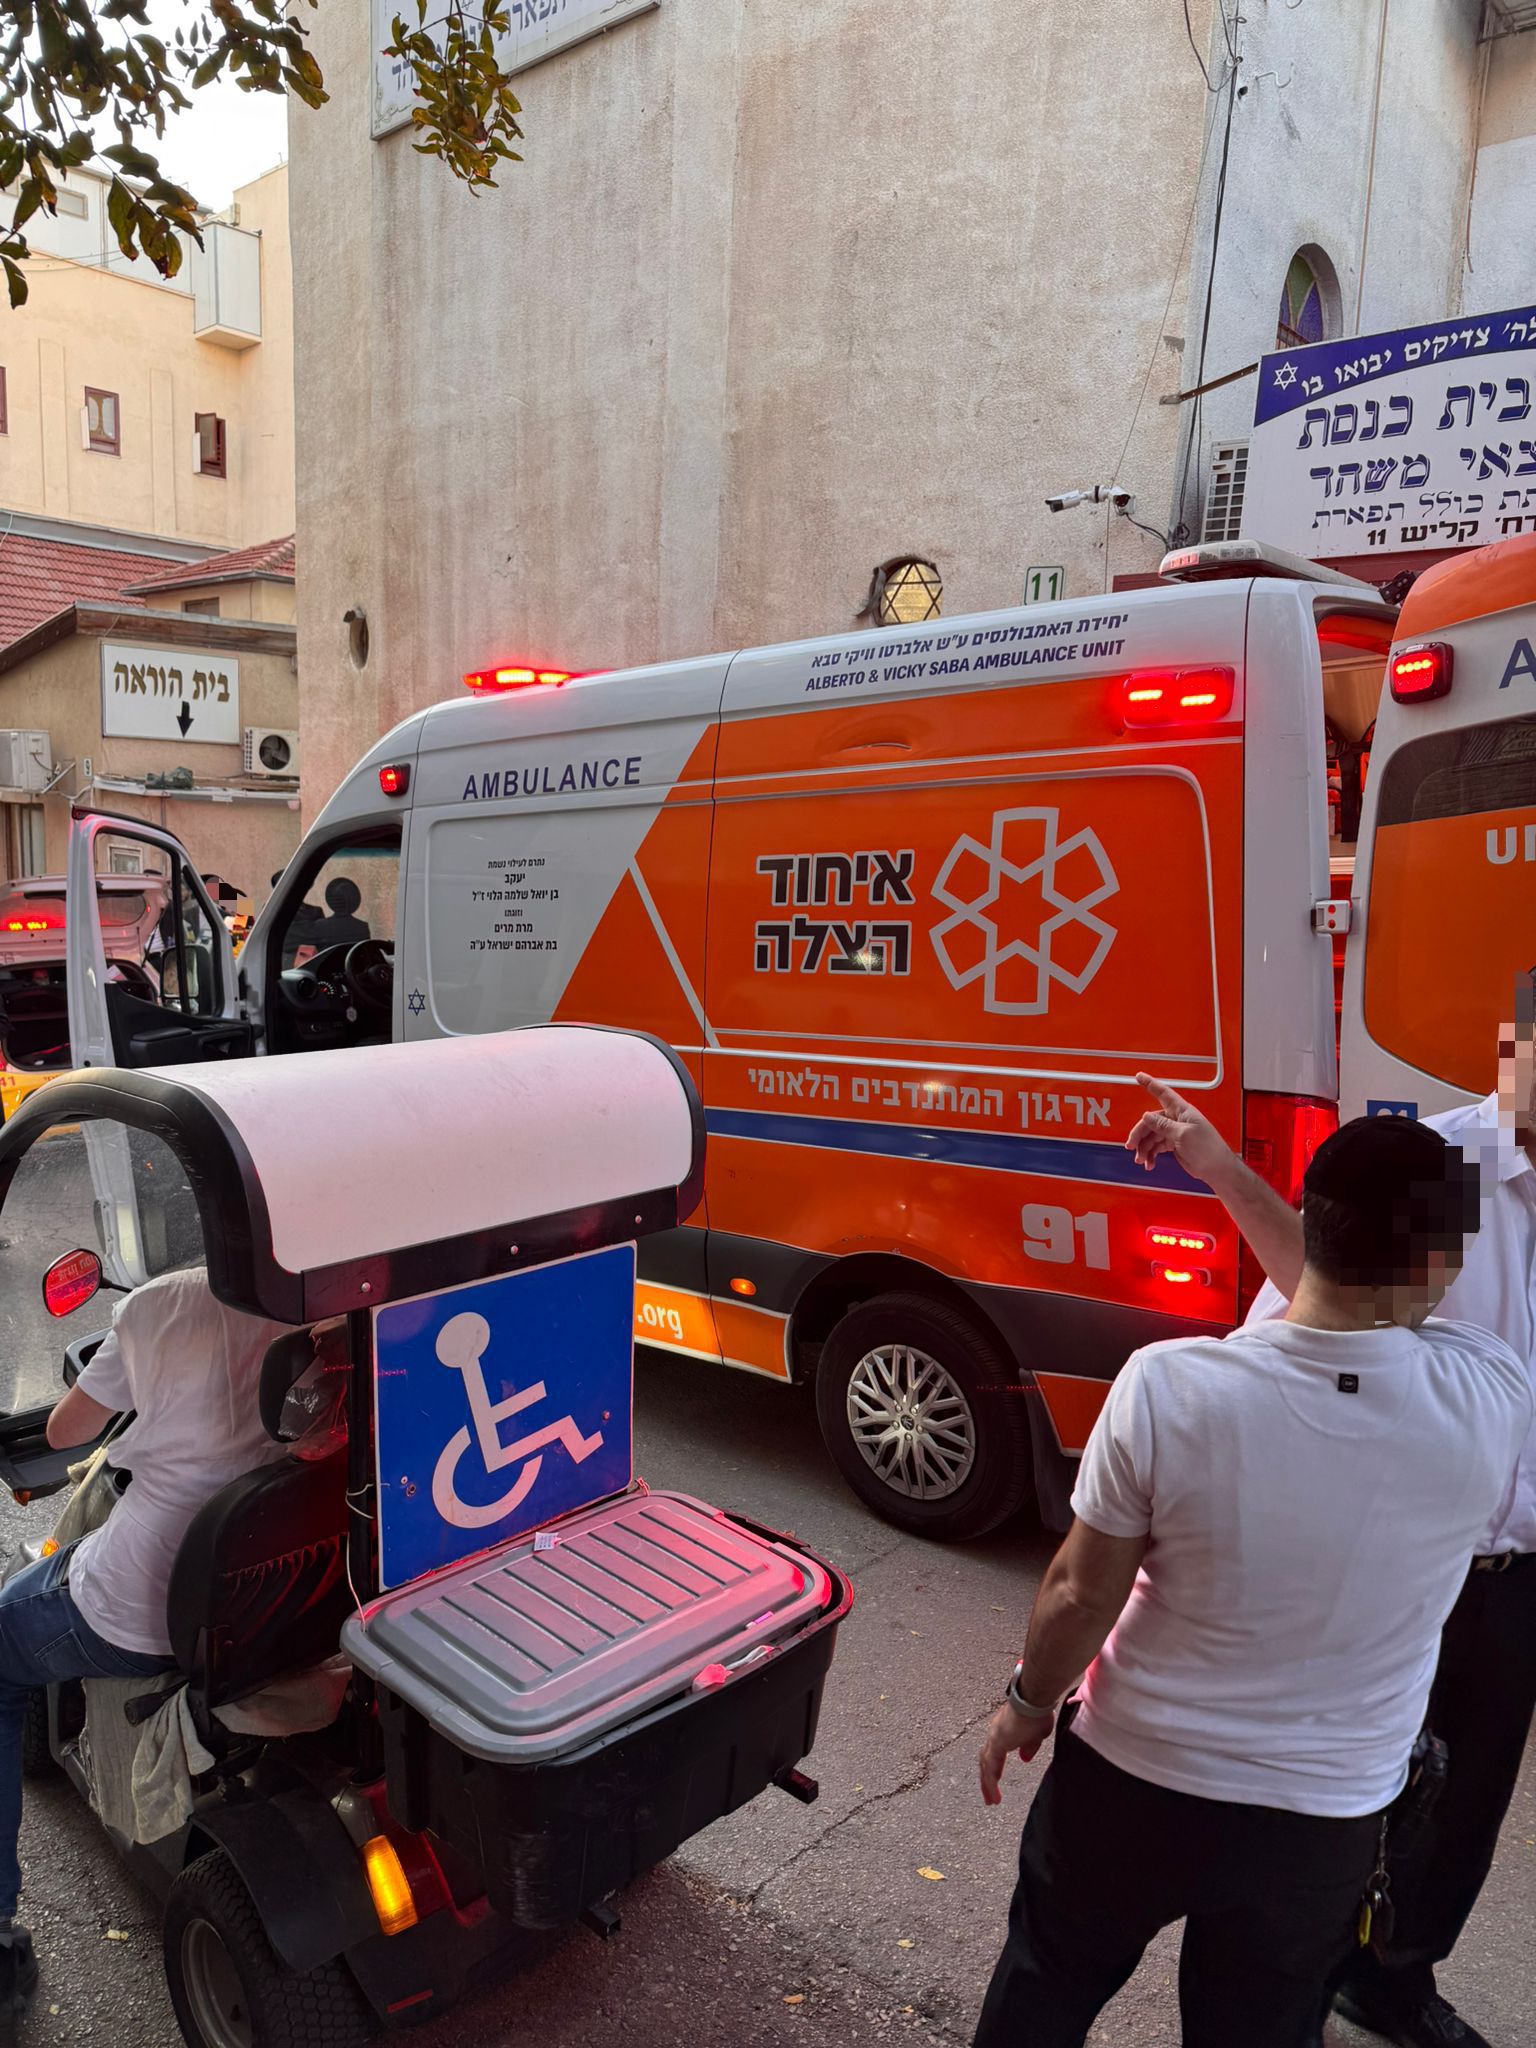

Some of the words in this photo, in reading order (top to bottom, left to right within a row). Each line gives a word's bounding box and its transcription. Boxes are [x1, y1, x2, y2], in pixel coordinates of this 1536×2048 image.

[1404, 326, 1490, 362] צדיקים
[1334, 350, 1392, 384] יבואו
[1301, 375, 1324, 397] בו
[1435, 377, 1531, 430] בית
[1296, 395, 1413, 449] כנסת
[1309, 453, 1431, 497] משהד
[1312, 502, 1405, 528] תפארת
[1419, 491, 1483, 517] כולל
[1367, 528, 1387, 545] 11
[1400, 520, 1479, 542] קליש
[1032, 572, 1057, 601] 11
[972, 620, 1073, 647] האמבולנסים
[1076, 614, 1129, 633] יחידת
[811, 652, 841, 668] סבא
[845, 647, 876, 666] וויקי
[878, 639, 933, 659] אלברטו
[805, 671, 866, 692] ALBERTO
[868, 669, 879, 684] &
[883, 663, 927, 681] VICKY
[929, 658, 970, 676] SABA
[973, 645, 1078, 671] AMBULANCE
[1082, 639, 1126, 658] UNIT
[113, 661, 184, 699] הוראה
[192, 669, 230, 702] בית
[463, 756, 642, 800] AMBULANCE
[488, 860, 506, 869] נשמת
[508, 858, 527, 868] לעילוי
[528, 858, 545, 867] נתרם
[504, 873, 526, 885] יעקב
[757, 850, 915, 905] איחוד
[486, 890, 502, 901] הלוי
[504, 889, 529, 900] שלמה
[530, 889, 548, 900] יואל
[550, 889, 559, 901] בן
[494, 923, 514, 933] מרים
[515, 923, 533, 933] מרת
[487, 939, 513, 950] ישראל
[515, 940, 544, 950] אברהם
[545, 940, 558, 950] בת
[754, 914, 912, 976] הצלה
[748, 1066, 840, 1101] הלאומי
[851, 1077, 1003, 1118] המתנדבים
[1018, 1090, 1111, 1129] ארגון
[1021, 1203, 1111, 1272] 91
[637, 1303, 683, 1340] .org
